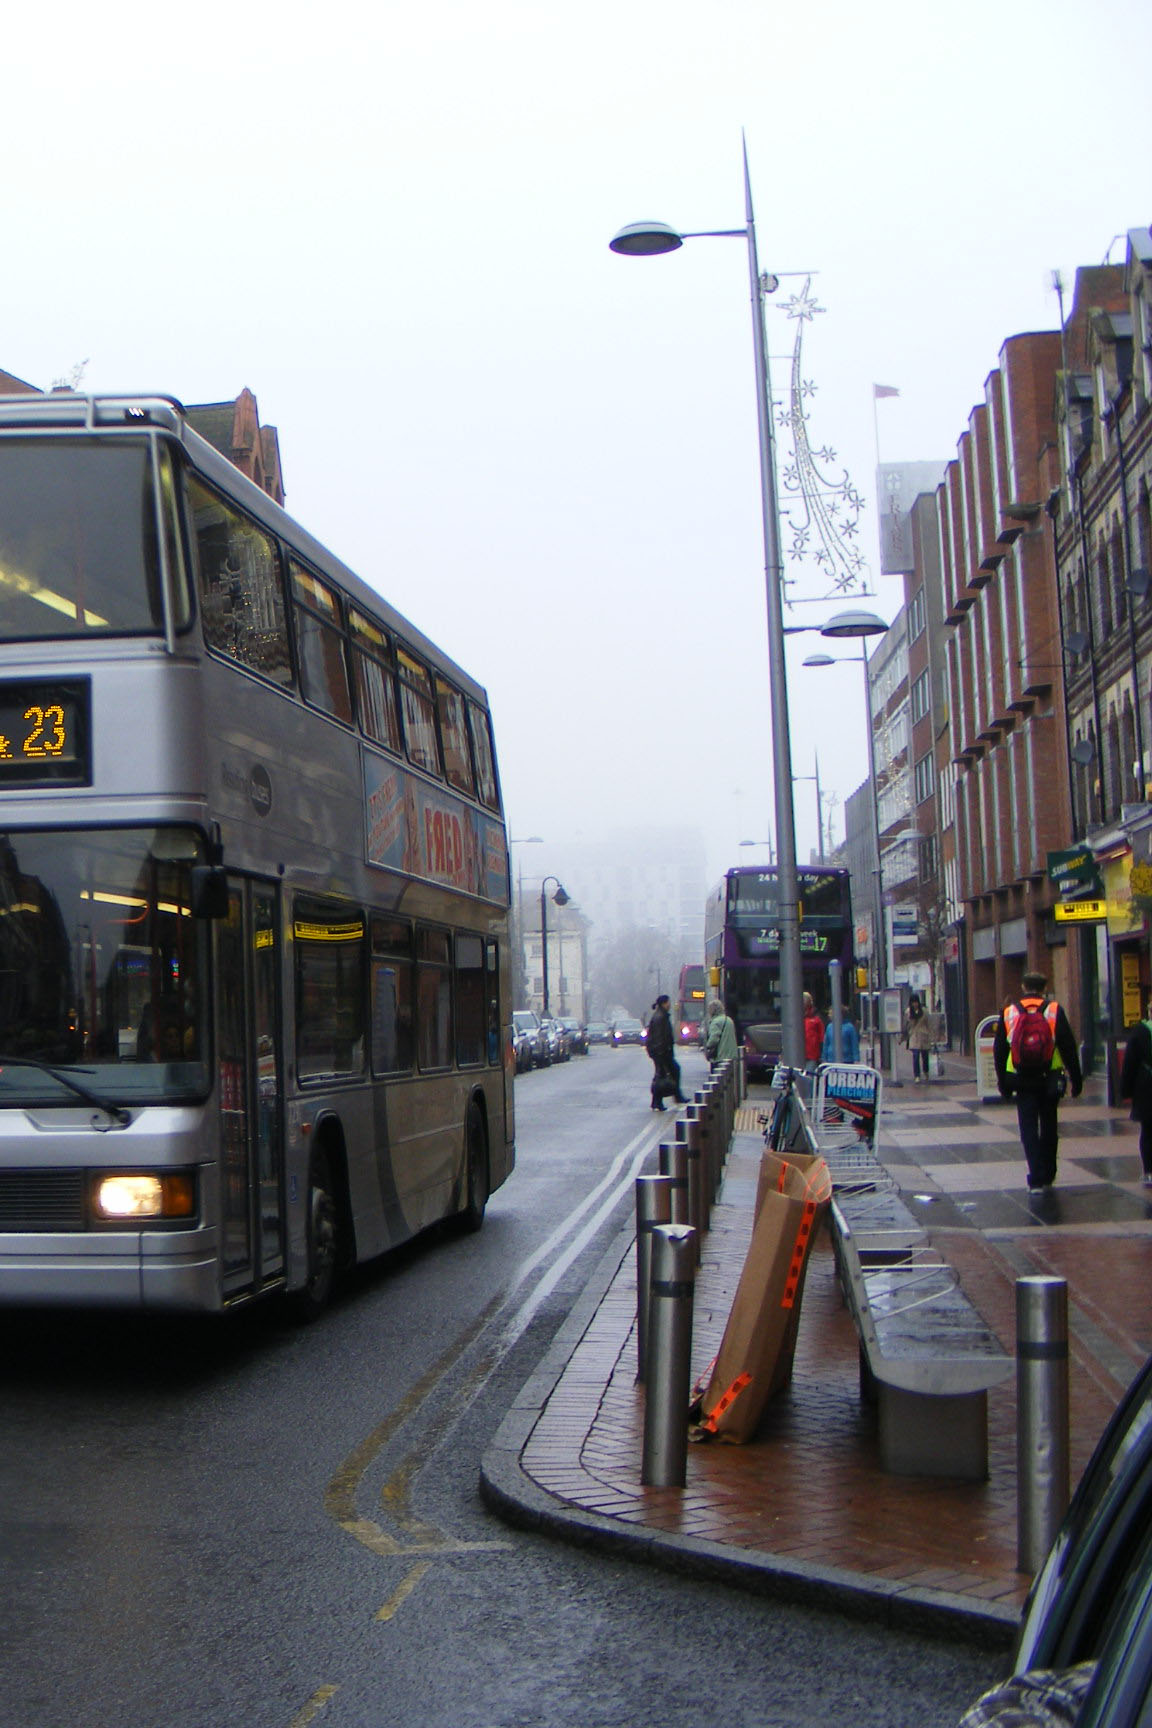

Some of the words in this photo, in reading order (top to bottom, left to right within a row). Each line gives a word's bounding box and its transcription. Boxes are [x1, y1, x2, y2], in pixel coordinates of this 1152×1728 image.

[22, 705, 65, 757] 23
[828, 1072, 875, 1088] URBAN
[827, 1086, 874, 1098] PIERCINGS
